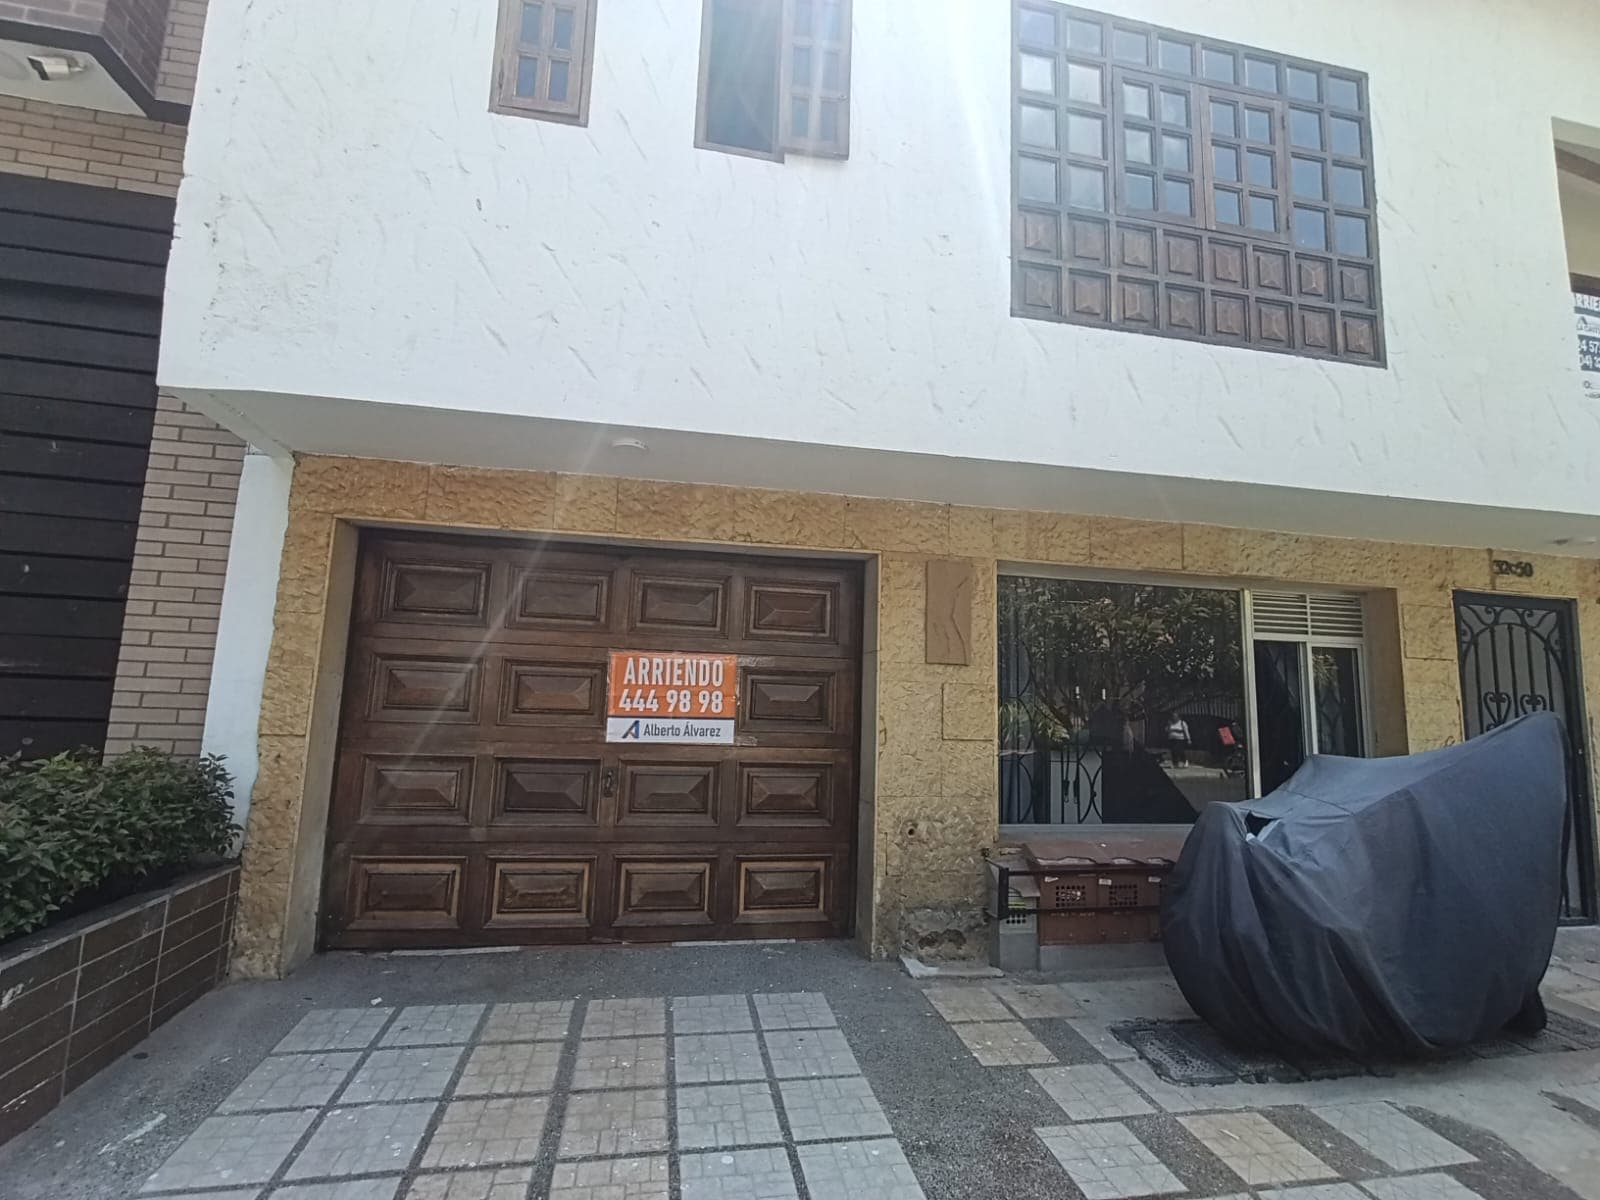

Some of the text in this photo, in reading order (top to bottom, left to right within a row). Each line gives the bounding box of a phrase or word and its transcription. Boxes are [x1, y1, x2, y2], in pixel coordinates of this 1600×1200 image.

[623, 657, 724, 687] ARRIENDO
[619, 688, 723, 714] 444 98 98
[643, 723, 681, 737] Alberto
[683, 721, 721, 737] Álvarez
